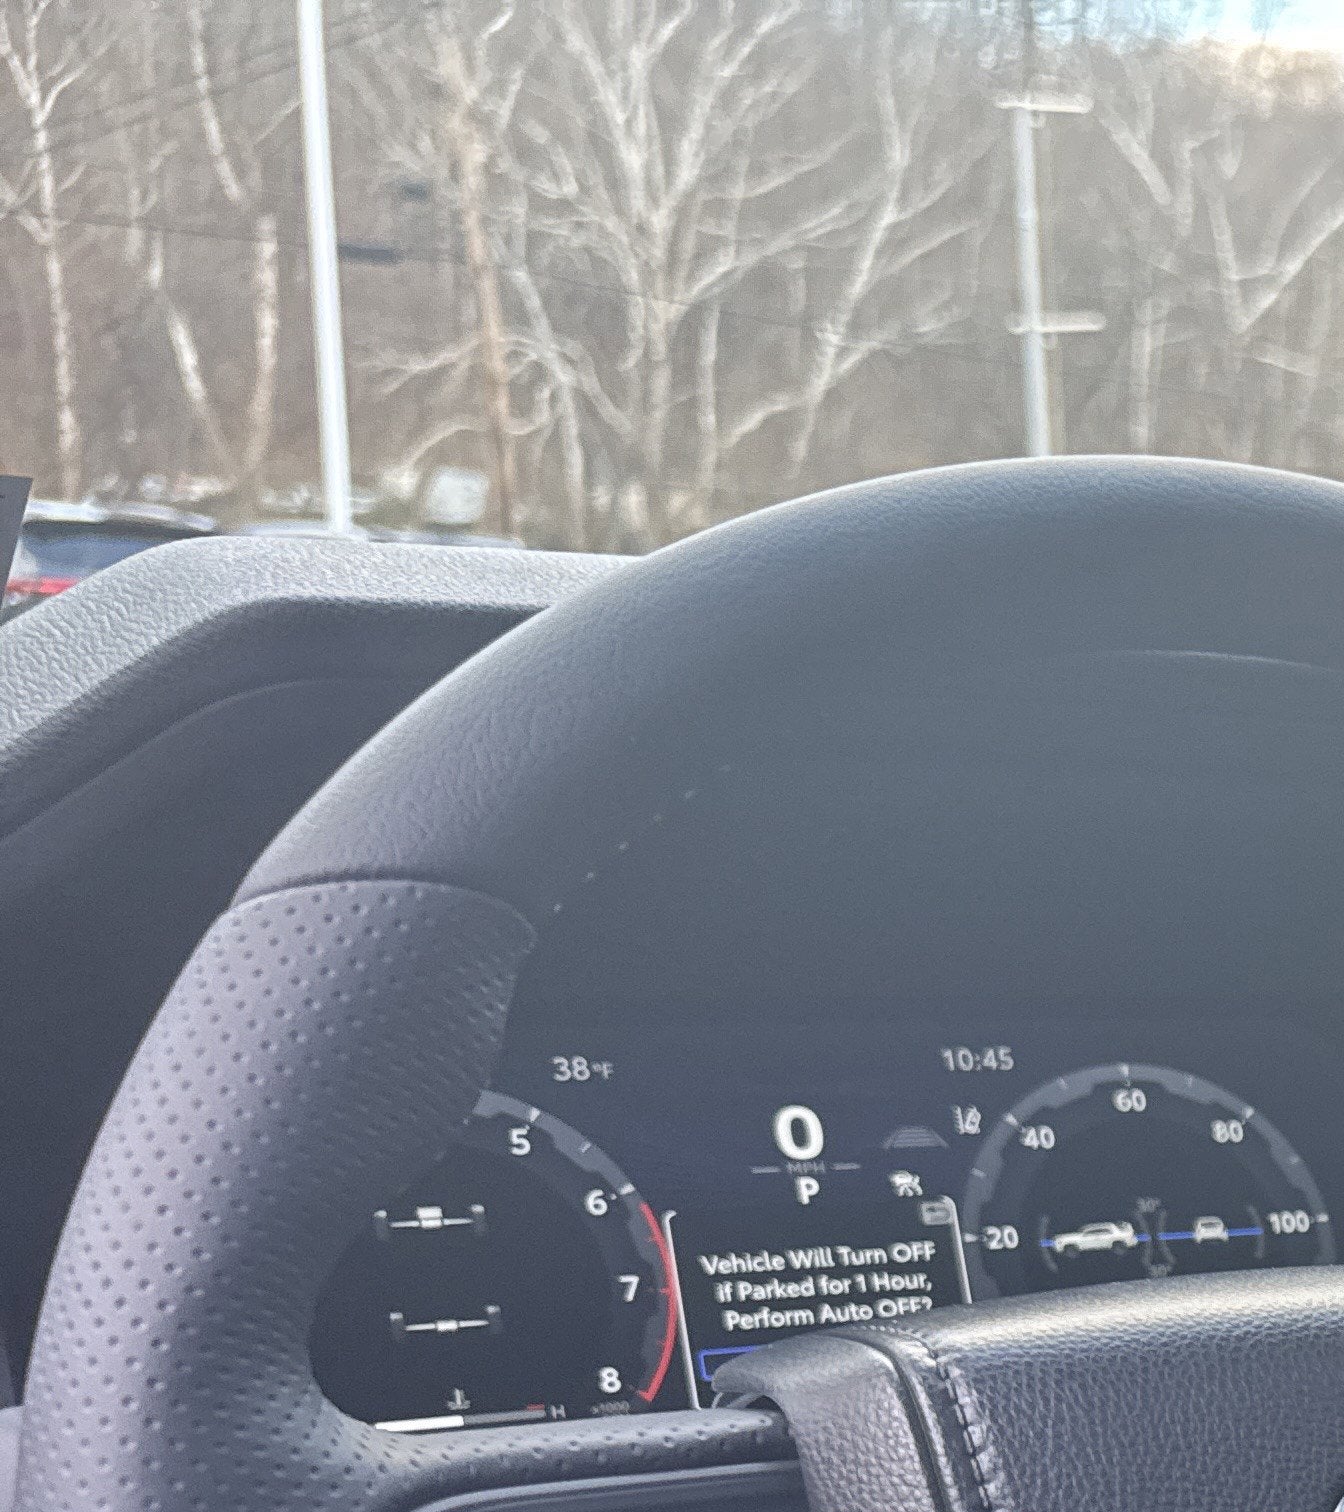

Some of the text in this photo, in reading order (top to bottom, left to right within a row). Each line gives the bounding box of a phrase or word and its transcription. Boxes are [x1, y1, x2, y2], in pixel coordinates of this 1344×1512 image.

[942, 1045, 1015, 1072] 10:45
[1114, 1087, 1147, 1113] 60
[508, 1127, 532, 1156] 5
[774, 1104, 825, 1160] 0
[1021, 1124, 1056, 1150] 40
[1210, 1118, 1244, 1144] 80
[584, 1188, 608, 1217] 6
[796, 1175, 820, 1205] P
[1268, 1209, 1311, 1235] 100
[985, 1225, 1019, 1250] 20
[698, 1239, 936, 1276] Vehicle Will Turn OFF
[616, 1273, 641, 1303] 7
[714, 1270, 933, 1304] if Parked for 1 Hour,
[722, 1295, 934, 1332] Perform Auto OFF?
[599, 1366, 622, 1394] 8
[549, 1403, 567, 1420] H
